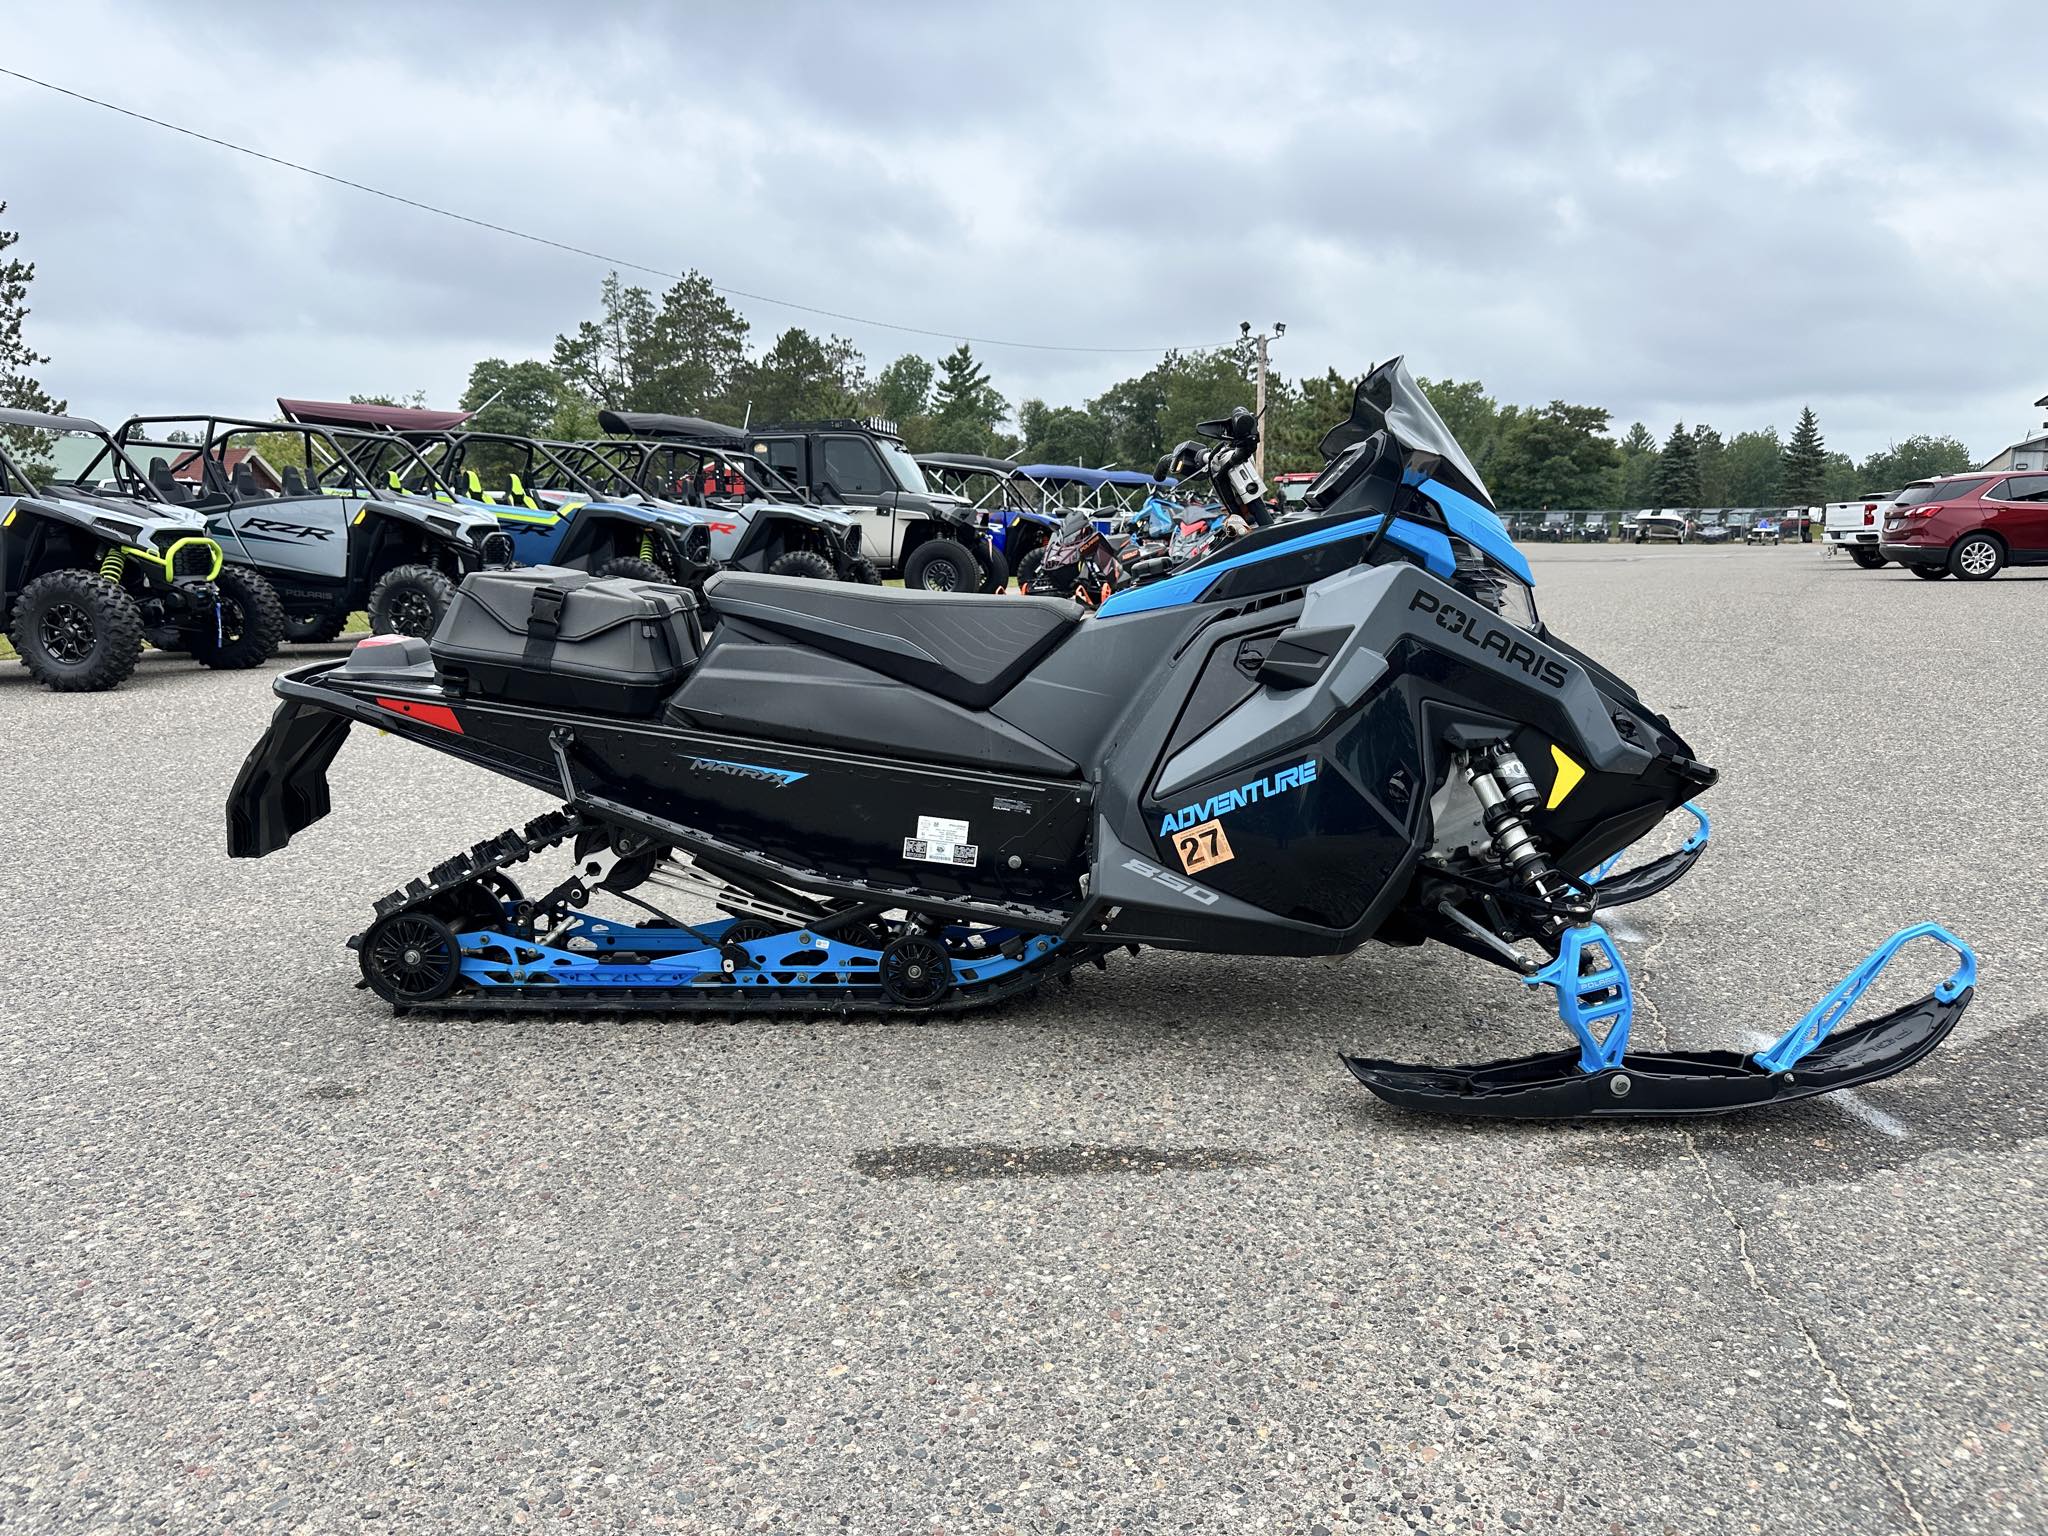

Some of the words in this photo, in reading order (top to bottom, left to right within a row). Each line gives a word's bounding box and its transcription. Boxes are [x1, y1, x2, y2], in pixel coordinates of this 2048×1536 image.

[240, 517, 335, 542] RZR
[286, 588, 333, 600] POLARIS
[1408, 589, 1569, 688] POLARIS
[689, 758, 788, 789] MATRYX
[1159, 760, 1317, 838] ADVENTURE
[1180, 828, 1220, 867] 27
[1121, 858, 1221, 907] 850
